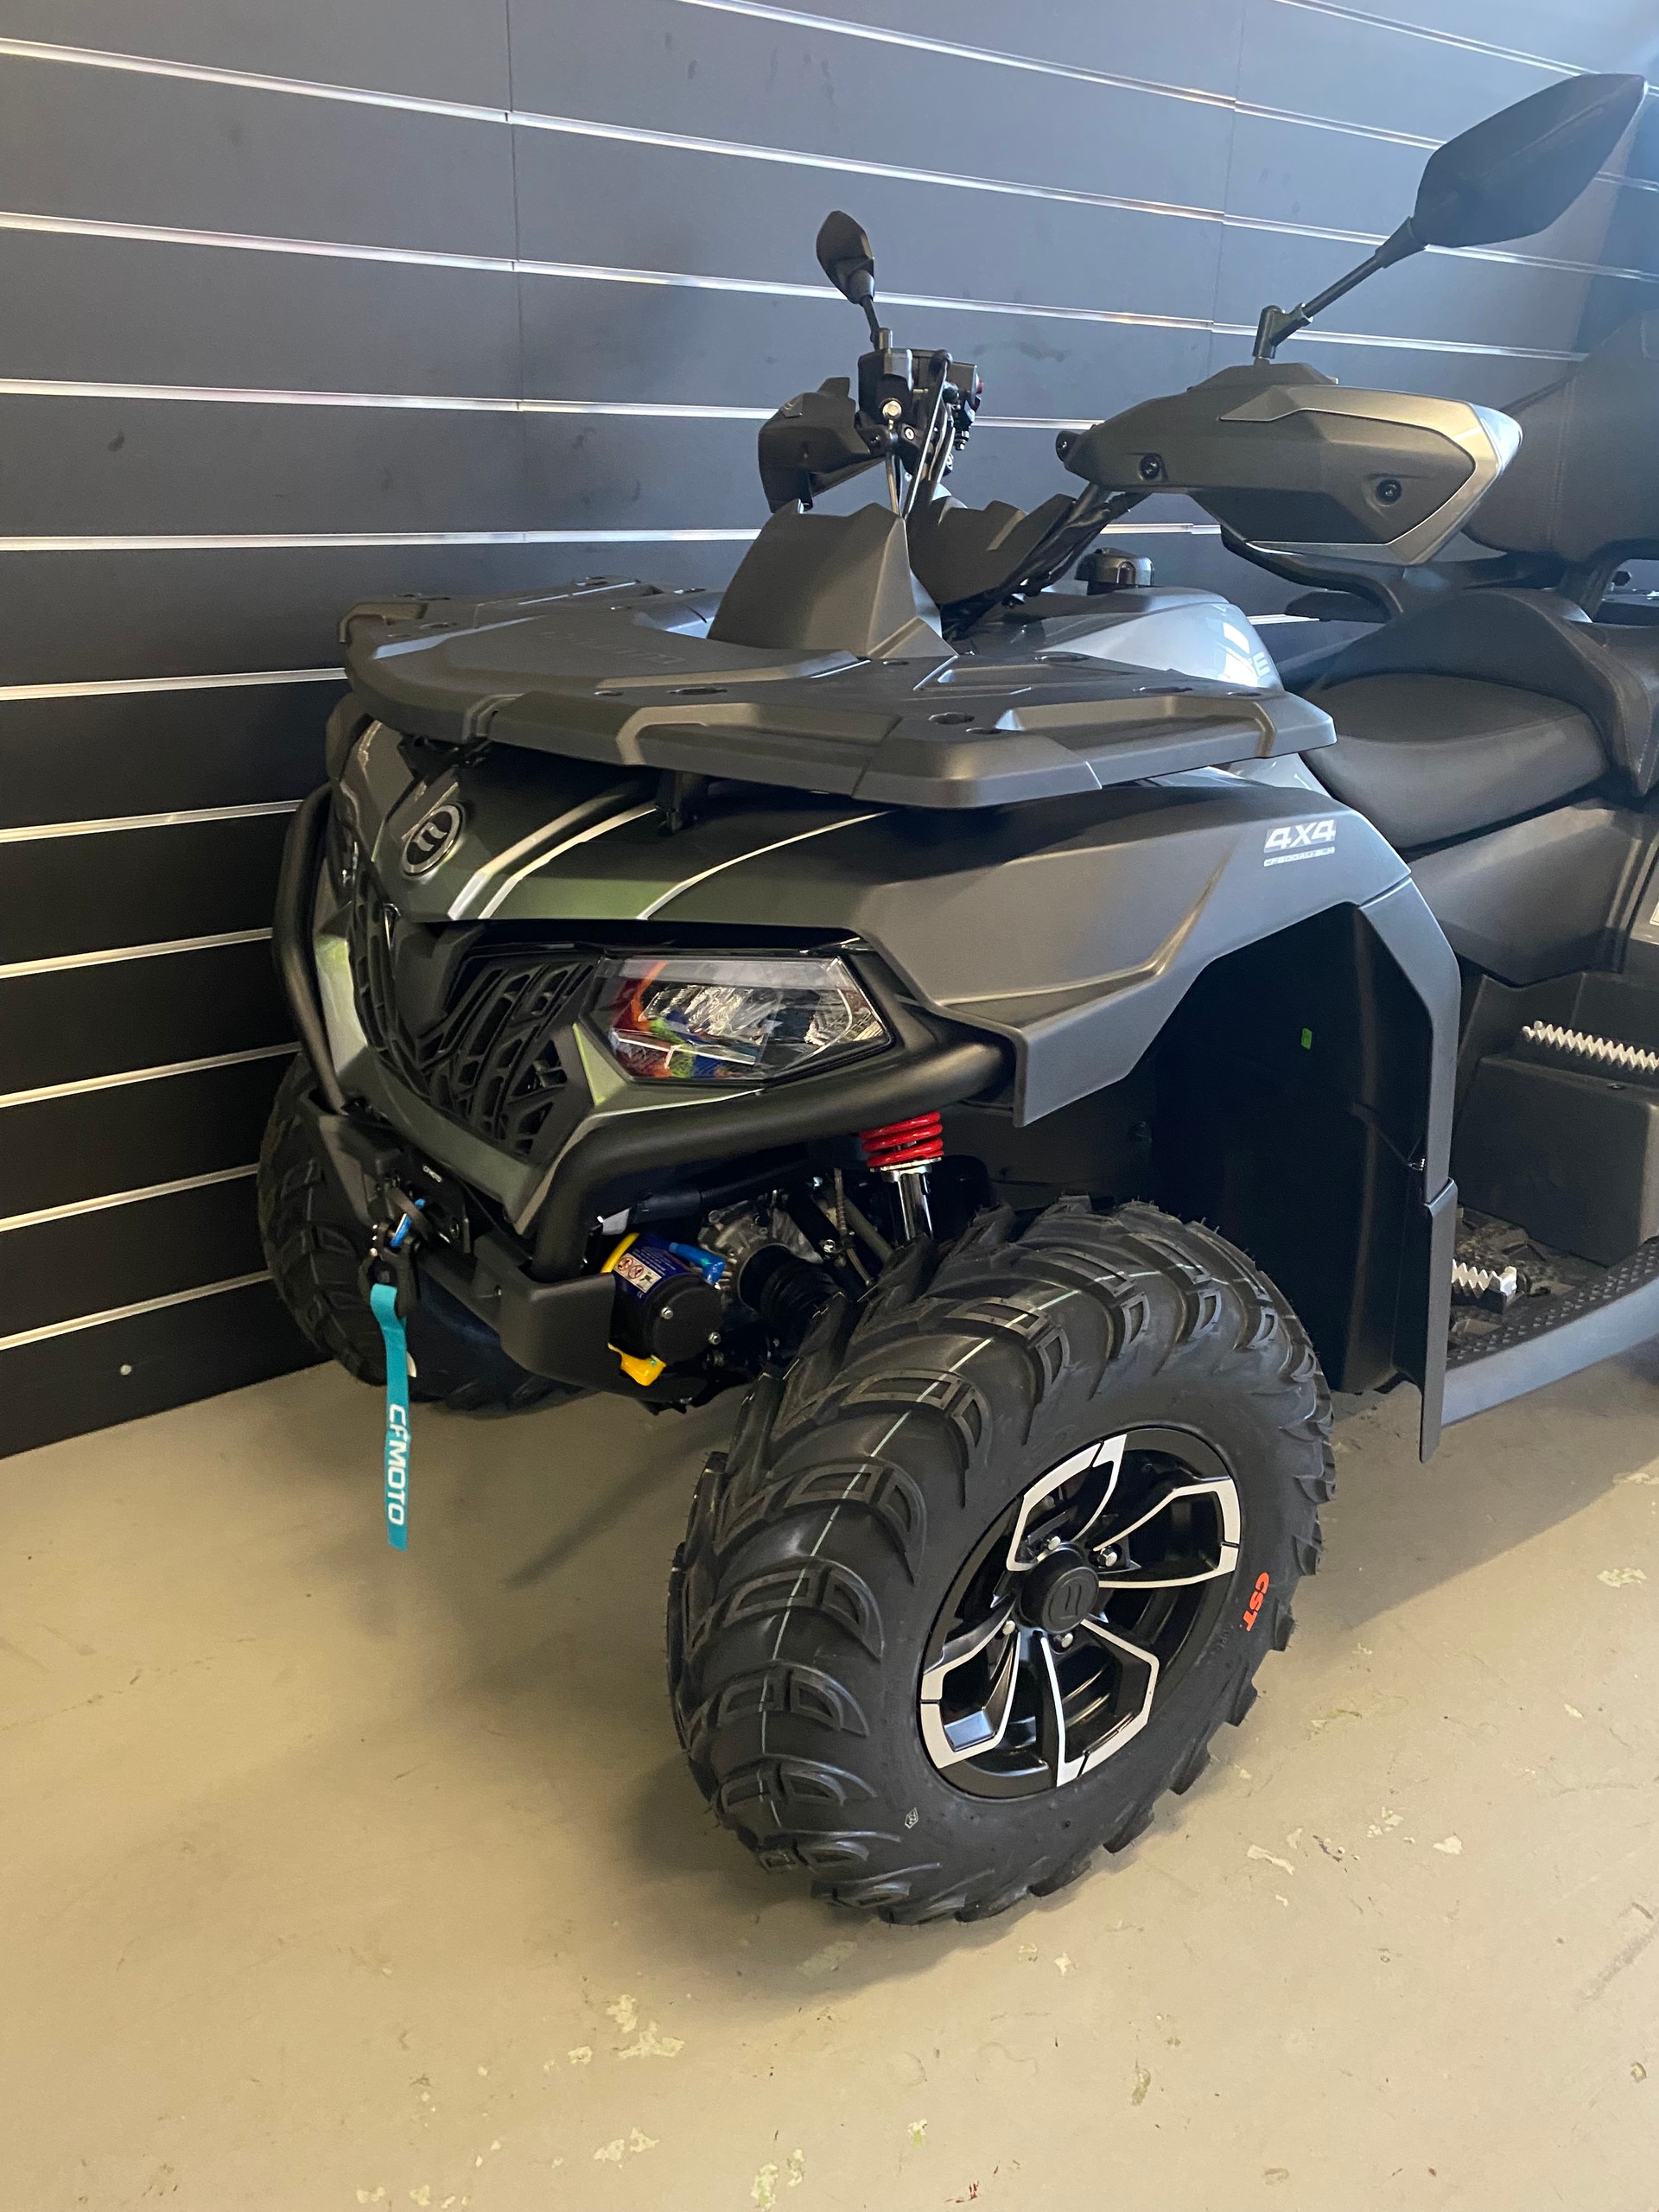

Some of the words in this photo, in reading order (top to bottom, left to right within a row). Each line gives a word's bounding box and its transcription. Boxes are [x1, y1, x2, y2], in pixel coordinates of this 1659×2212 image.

[1264, 819, 1337, 849] 4X4
[388, 1404, 408, 1525] CFMOTO
[1243, 1572, 1269, 1632] CST
